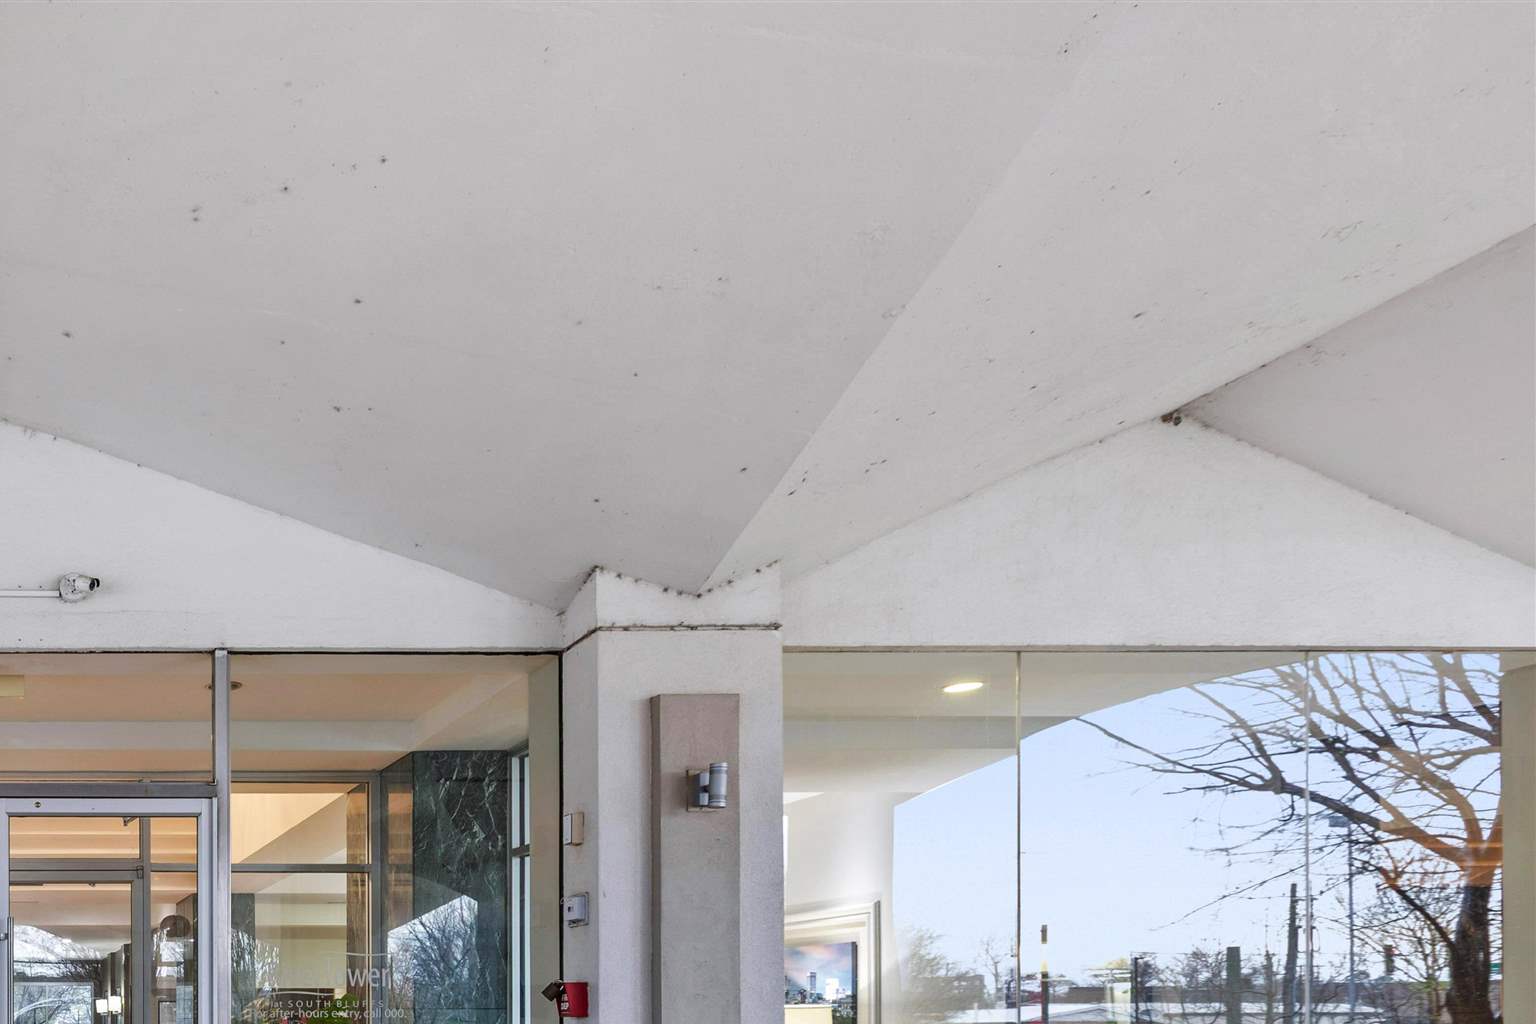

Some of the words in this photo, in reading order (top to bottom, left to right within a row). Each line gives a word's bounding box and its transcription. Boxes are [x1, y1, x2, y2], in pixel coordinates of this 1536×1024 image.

[287, 1000, 331, 1008] SOUTH
[336, 1000, 385, 1008] BLUFS
[270, 1008, 329, 1018] after-hours
